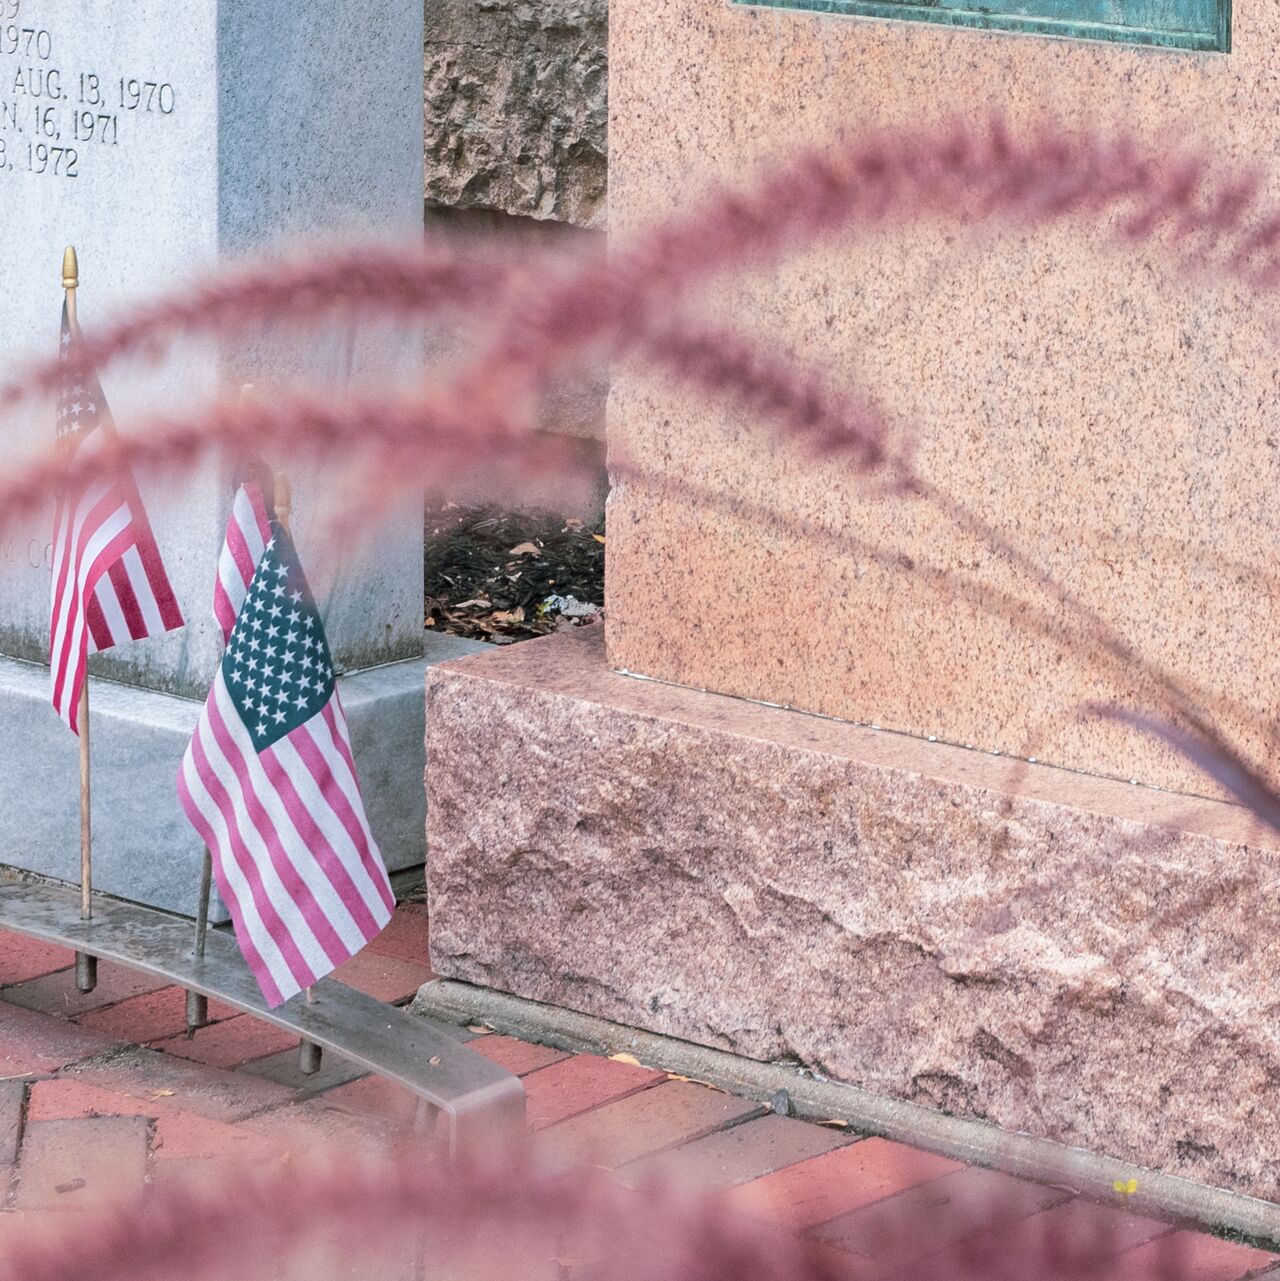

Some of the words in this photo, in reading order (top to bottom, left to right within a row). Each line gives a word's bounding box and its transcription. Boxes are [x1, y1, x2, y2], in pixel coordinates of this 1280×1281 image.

[12, 67, 68, 101] AUG.
[79, 72, 105, 108] 13,
[120, 76, 175, 115] 1970
[34, 106, 60, 140] 16,
[74, 109, 118, 145] 1971
[28, 141, 79, 177] 1972
